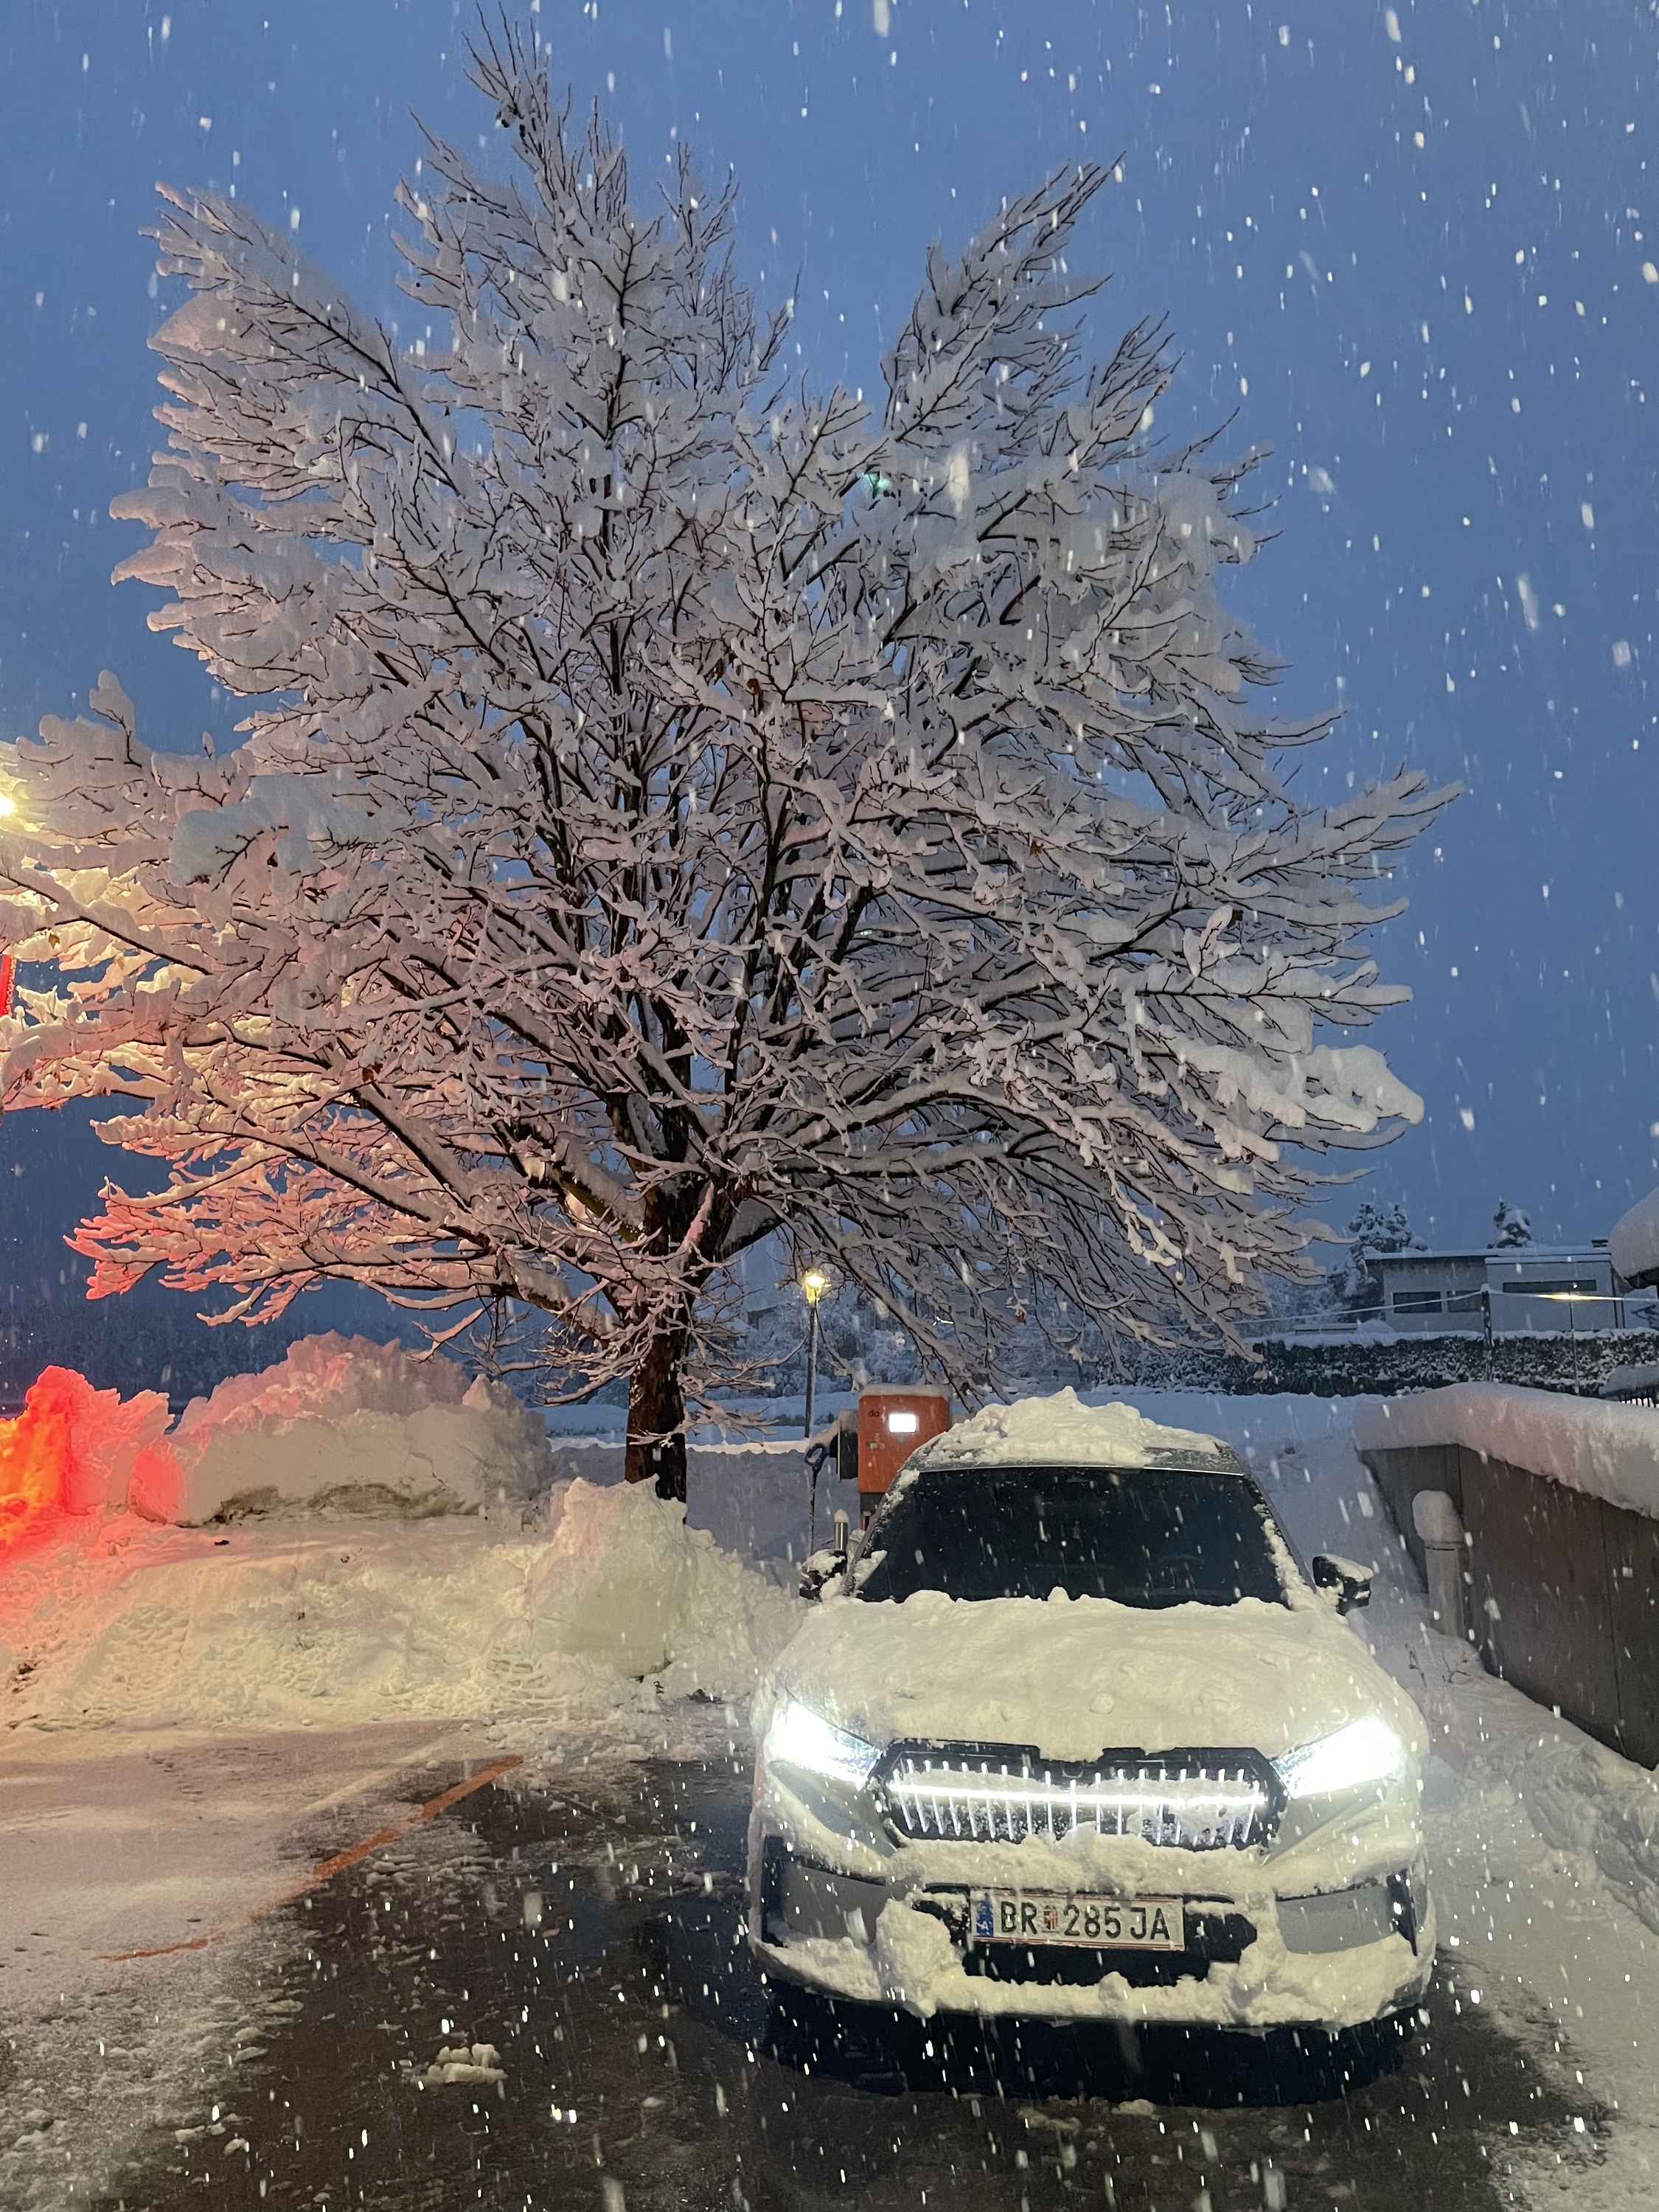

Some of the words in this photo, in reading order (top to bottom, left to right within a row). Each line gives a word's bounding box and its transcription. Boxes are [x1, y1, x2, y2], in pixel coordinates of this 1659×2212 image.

[981, 1921, 989, 1930] A
[1001, 1902, 1037, 1935] BR
[1063, 1905, 1121, 1938] 285
[1130, 1907, 1170, 1940] JA
